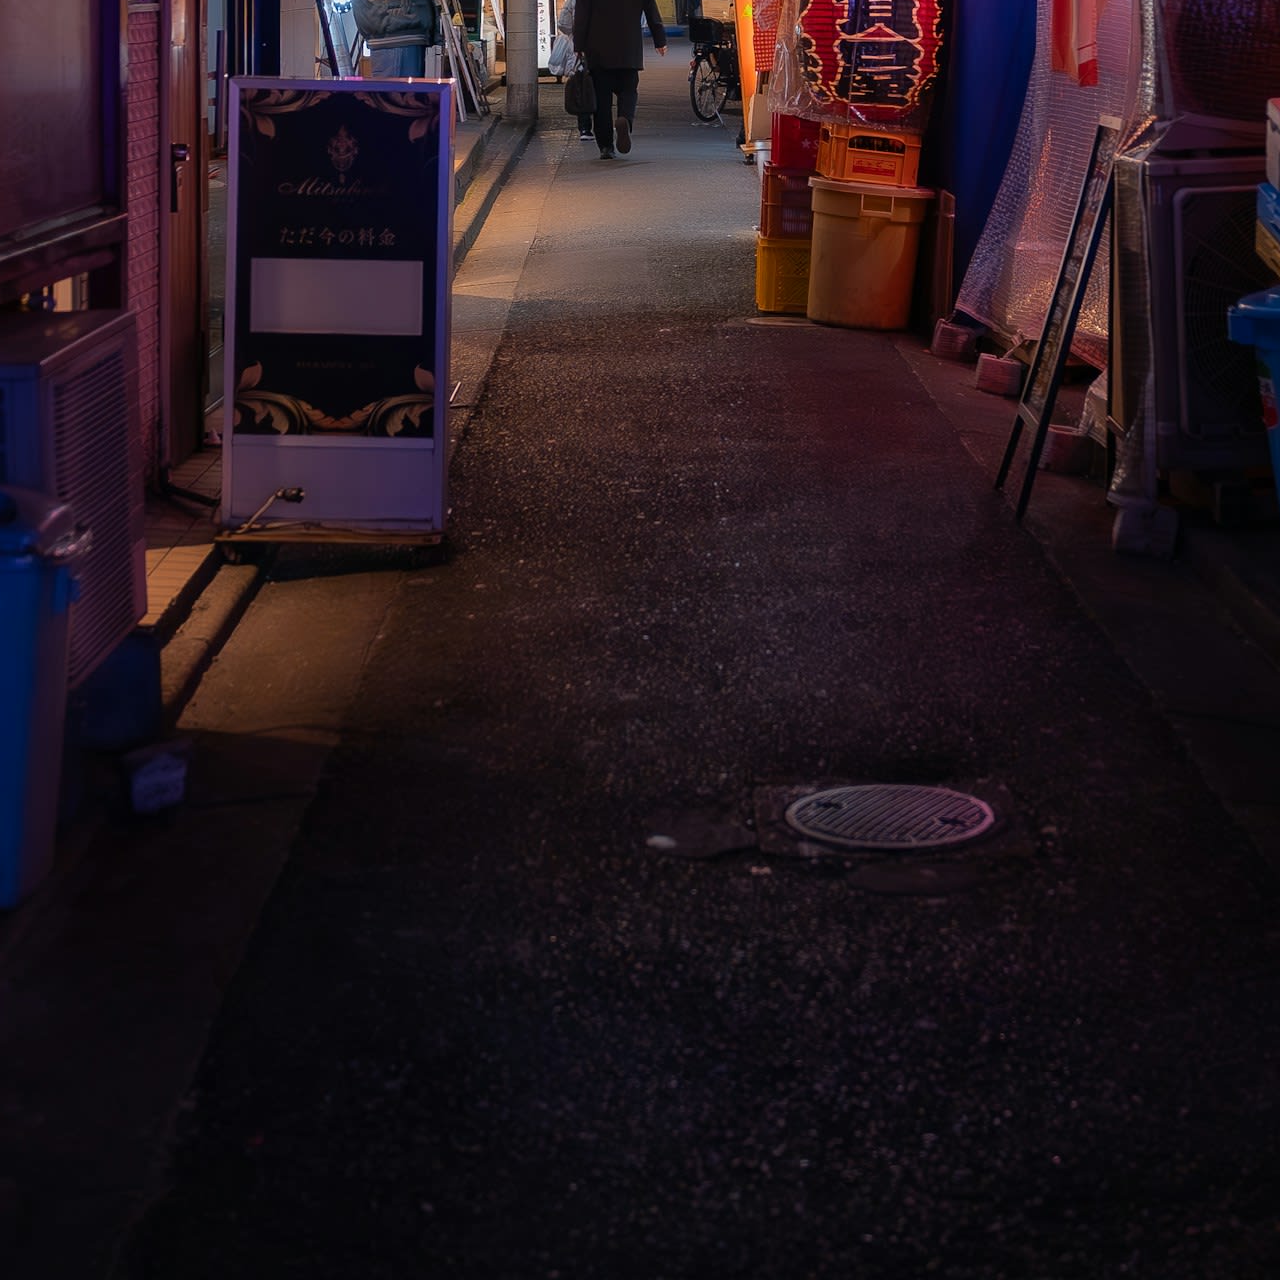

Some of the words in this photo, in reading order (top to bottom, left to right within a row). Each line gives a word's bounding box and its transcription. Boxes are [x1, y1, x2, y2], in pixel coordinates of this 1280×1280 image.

[279, 226, 398, 247] ただ今の料金
